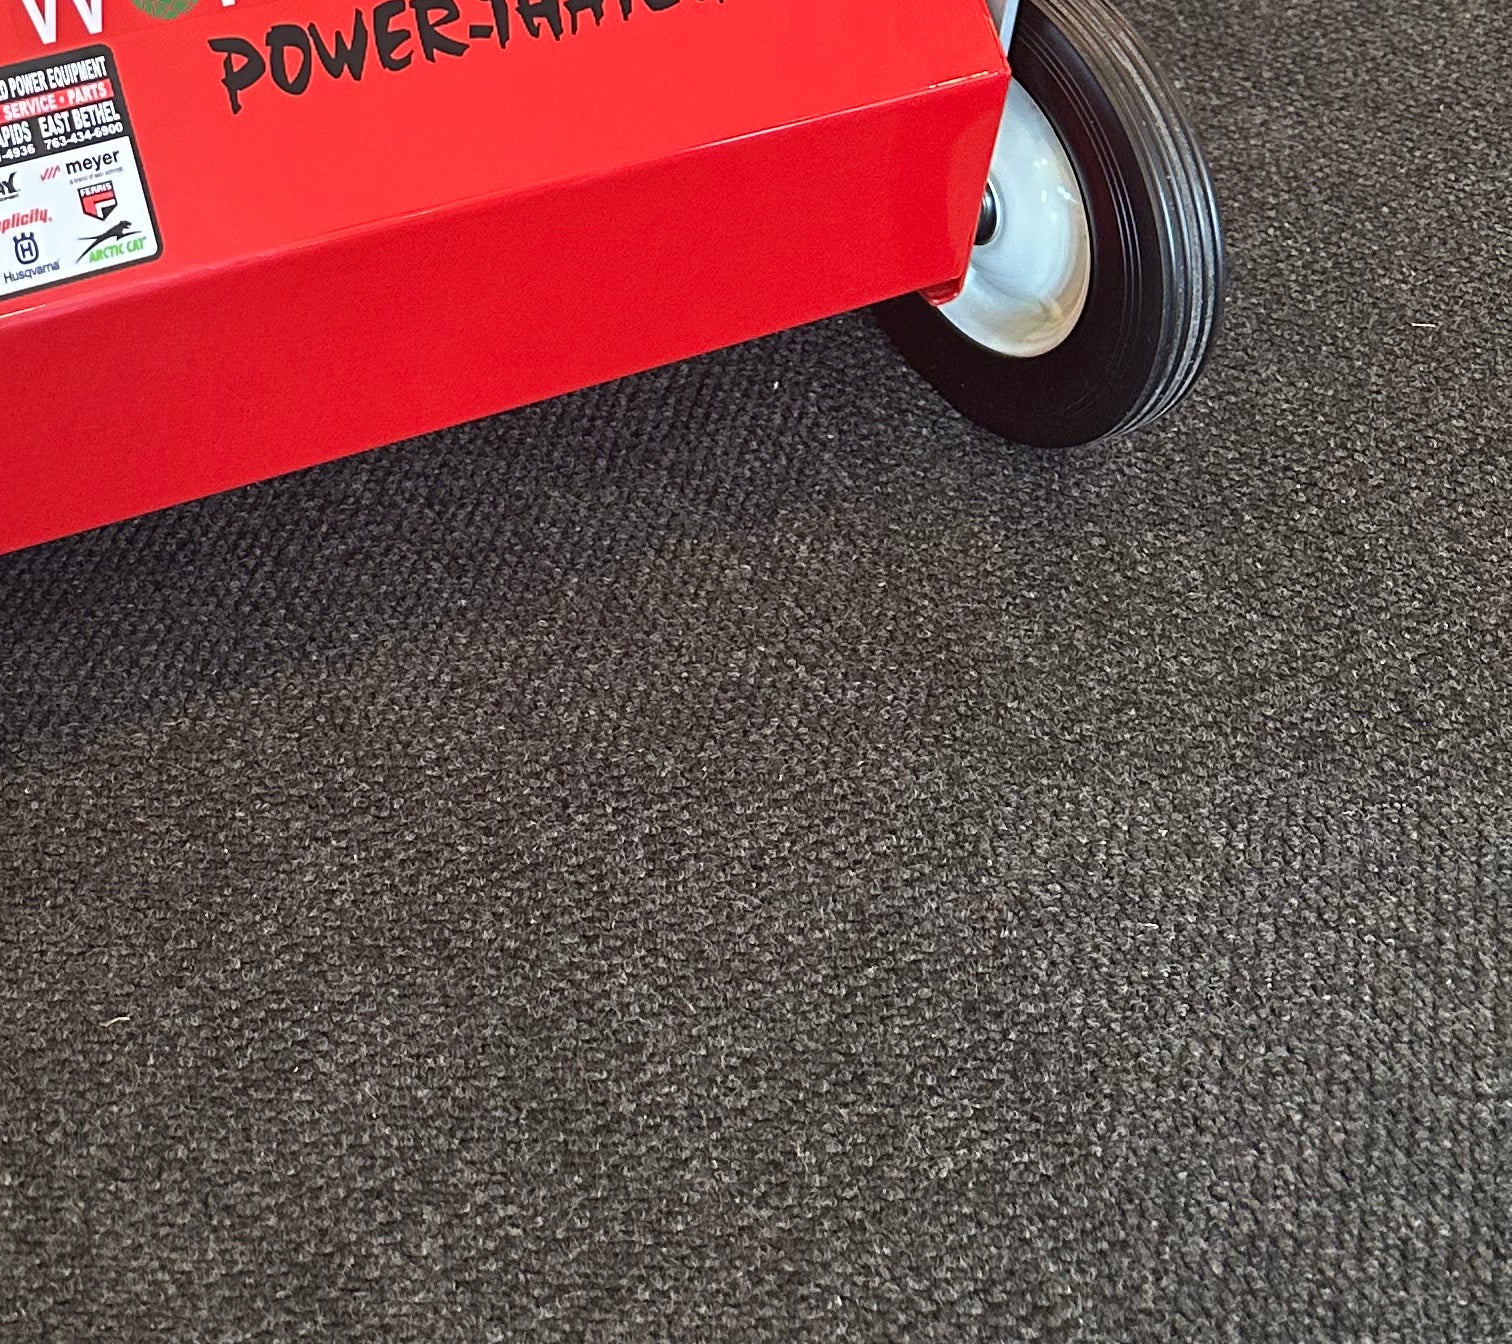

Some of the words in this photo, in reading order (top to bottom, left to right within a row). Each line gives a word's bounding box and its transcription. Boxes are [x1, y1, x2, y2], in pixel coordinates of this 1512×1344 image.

[8, 70, 48, 98] POWER
[46, 56, 108, 89] EQUIPMENT
[2, 94, 57, 121] SERVICE
[67, 82, 108, 106] PARTS
[39, 112, 70, 138] EAST
[71, 101, 120, 130] BETHEL
[66, 150, 120, 175] meyer
[80, 182, 112, 198] FERRIS
[89, 243, 124, 263] ARCTIC
[126, 237, 147, 253] CAT
[3, 261, 60, 284] Husqvarna
